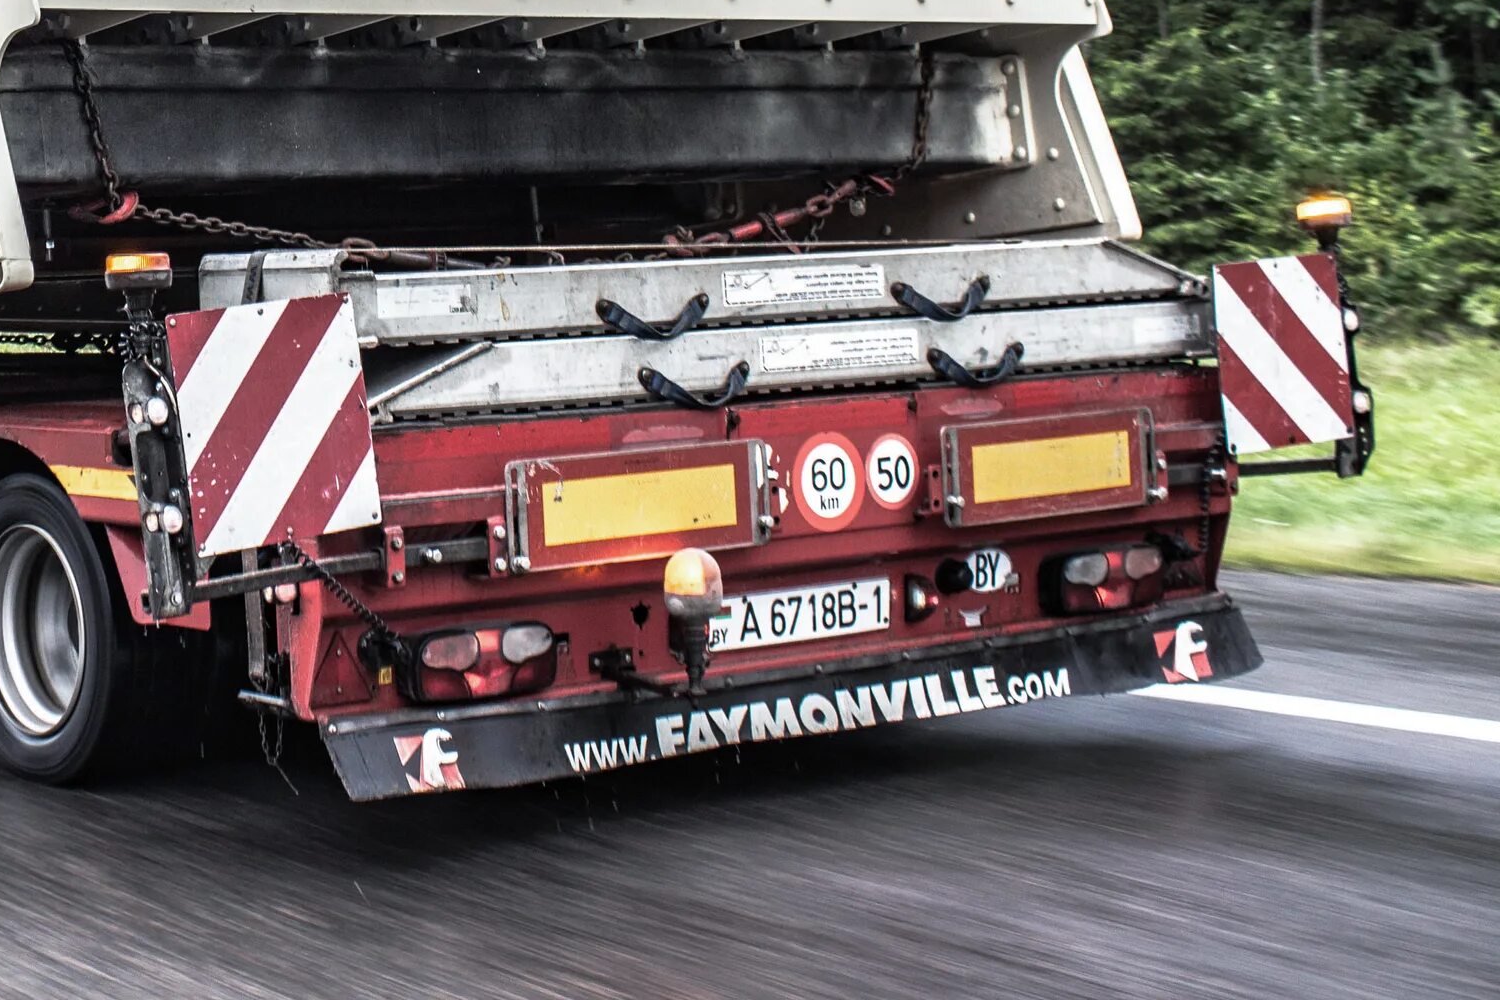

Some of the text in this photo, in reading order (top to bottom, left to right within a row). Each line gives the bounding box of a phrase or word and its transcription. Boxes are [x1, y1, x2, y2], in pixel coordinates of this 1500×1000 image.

[811, 457, 846, 492] 60
[877, 455, 910, 491] 50
[820, 495, 839, 510] km
[976, 552, 1000, 588] BY
[740, 585, 882, 642] A 6718B-1
[712, 628, 728, 645] BY
